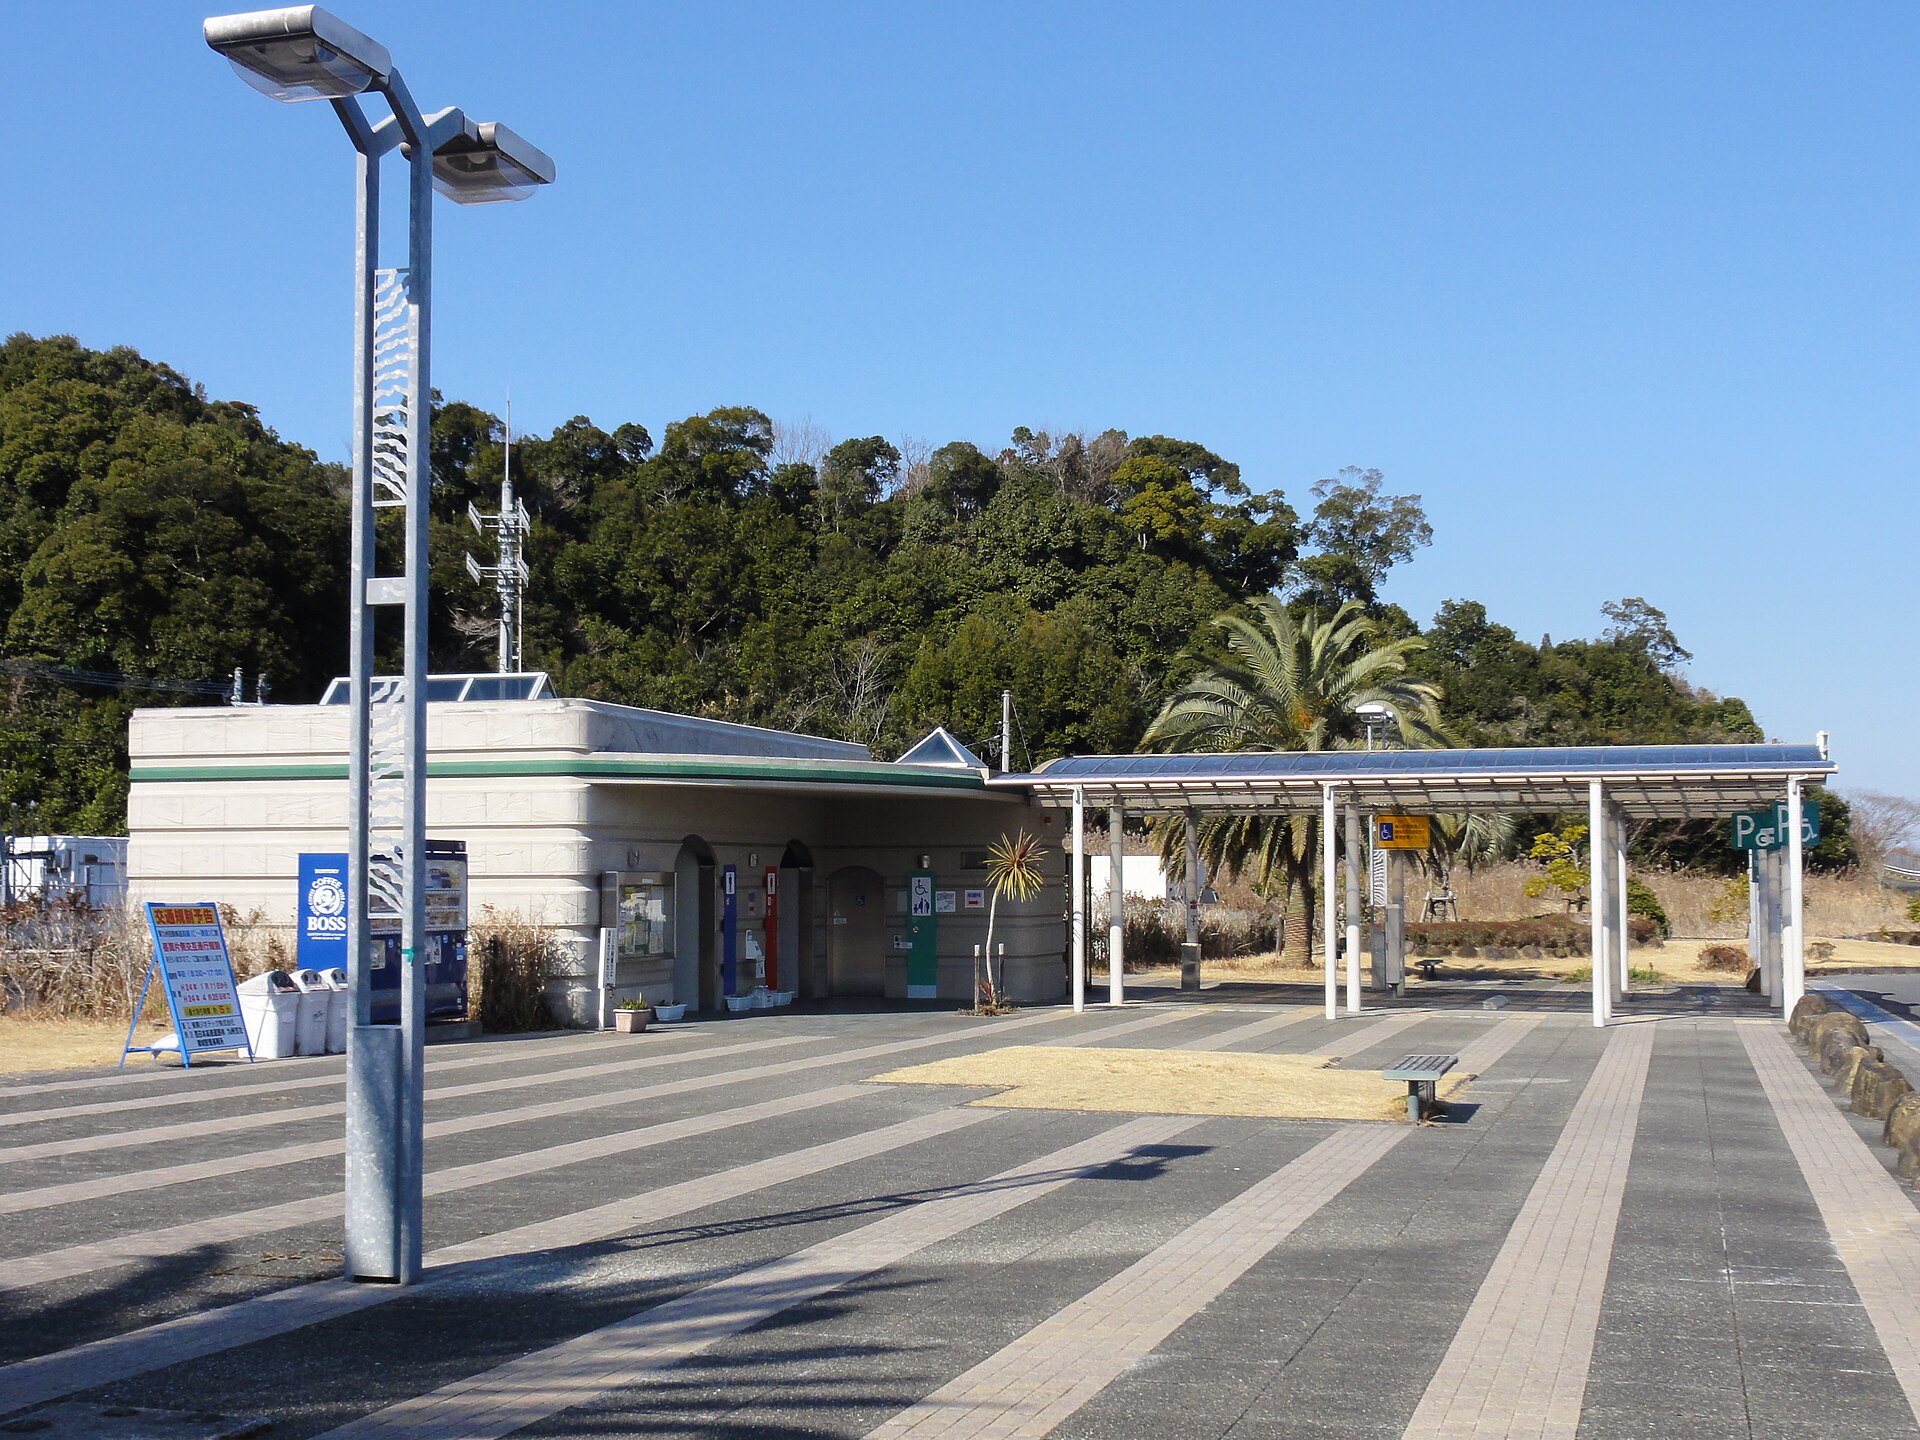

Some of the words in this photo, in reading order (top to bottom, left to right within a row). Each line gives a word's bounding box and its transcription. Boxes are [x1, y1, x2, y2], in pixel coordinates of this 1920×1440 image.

[1737, 815, 1755, 847] P
[311, 877, 342, 889] COFFEE
[307, 916, 346, 931] BOSS
